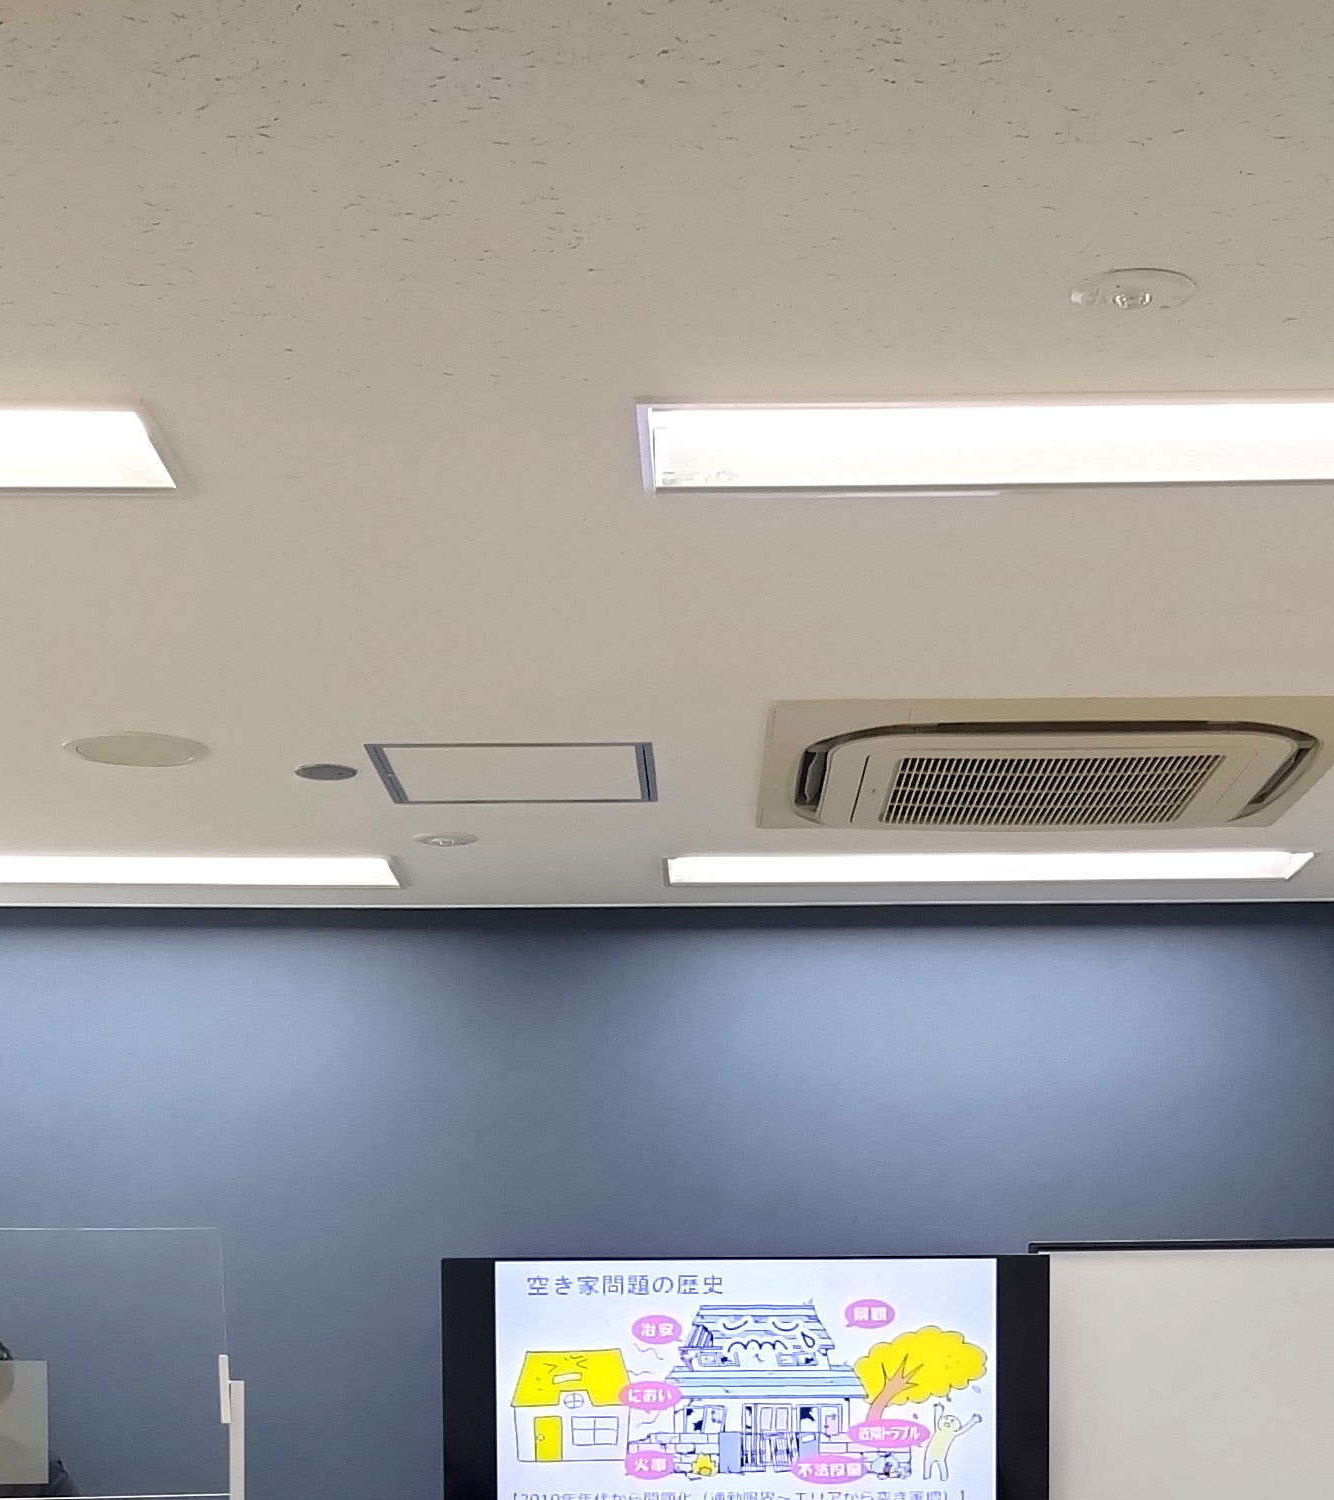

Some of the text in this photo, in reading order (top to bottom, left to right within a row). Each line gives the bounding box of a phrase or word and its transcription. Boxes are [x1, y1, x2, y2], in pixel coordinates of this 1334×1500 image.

[527, 1274, 723, 1296] 空き家問題の歴史
[641, 1323, 674, 1337] 治安
[628, 1389, 672, 1403] におい
[634, 1458, 667, 1472] 火事
[798, 1462, 862, 1477] 不法投棄
